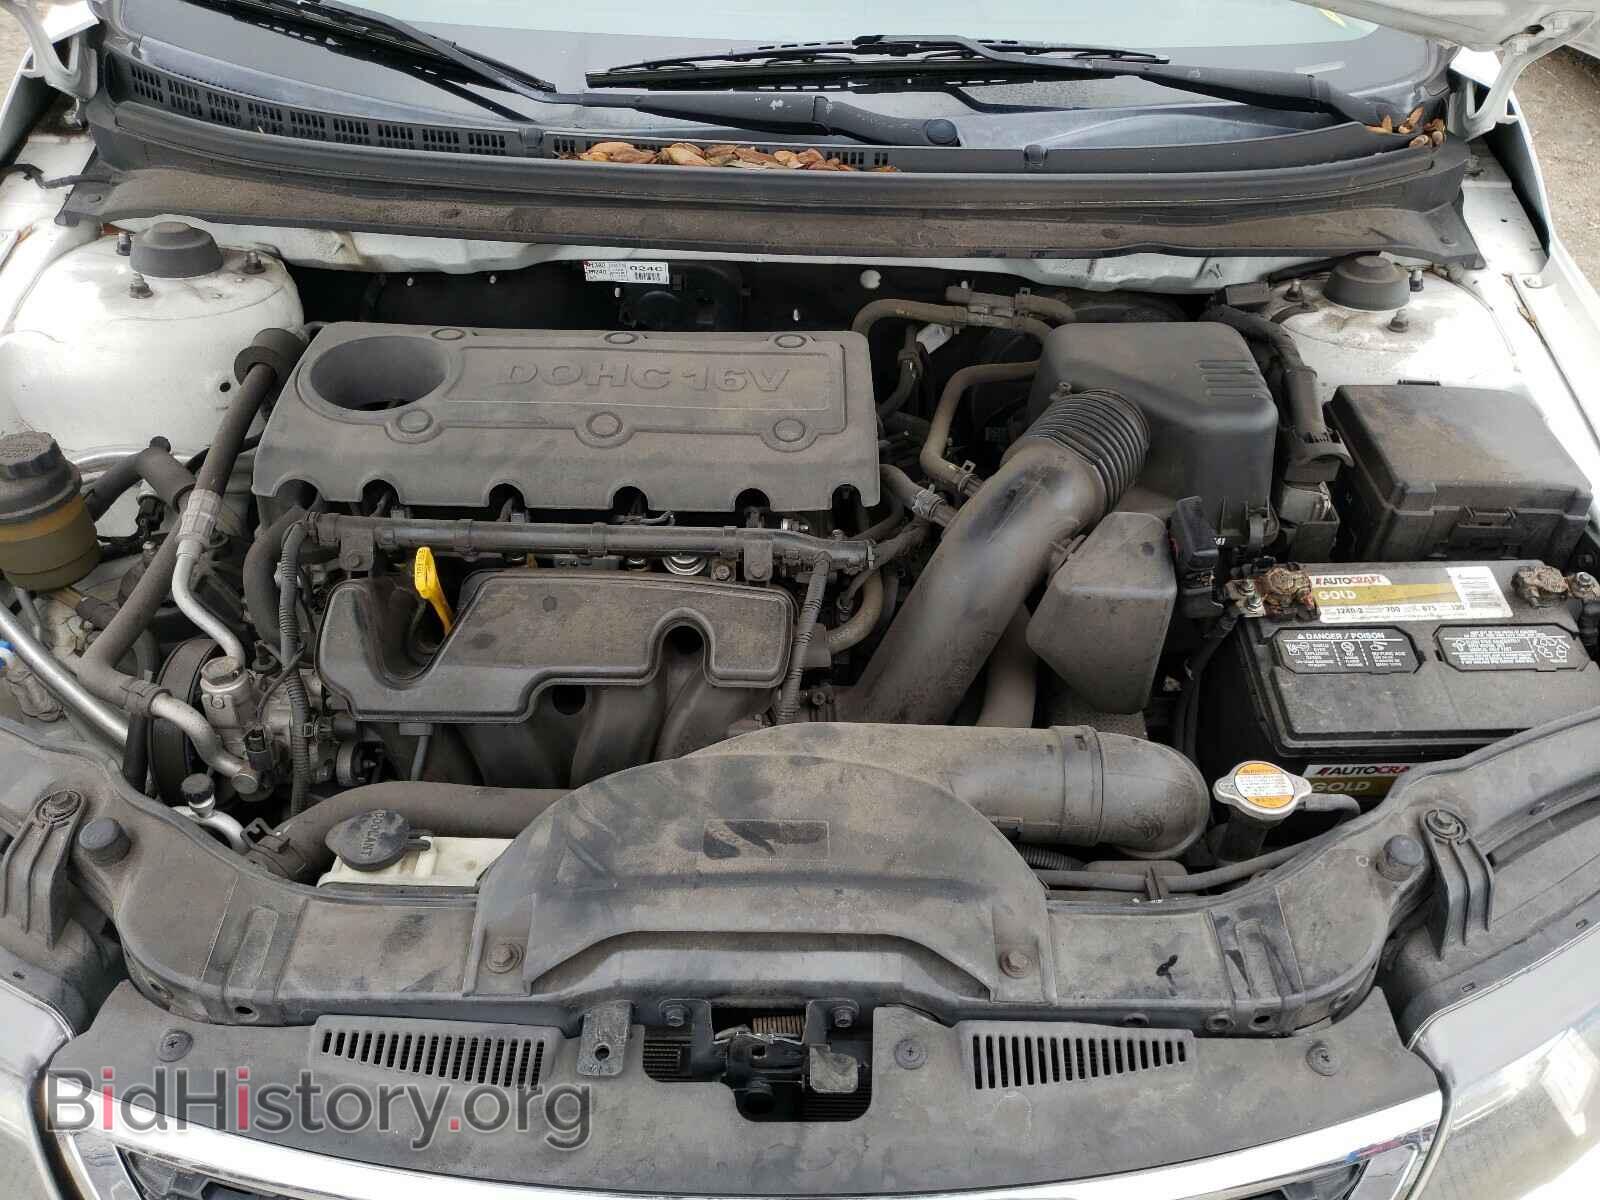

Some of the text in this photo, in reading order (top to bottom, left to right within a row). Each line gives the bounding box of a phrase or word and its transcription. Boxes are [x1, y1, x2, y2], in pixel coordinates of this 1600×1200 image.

[497, 363, 672, 390] DOHC
[681, 367, 791, 392] 16V
[1318, 590, 1357, 600] GOLD
[1350, 632, 1385, 640] POISON
[1312, 782, 1371, 792] GOLD
[361, 812, 384, 856] COOLANT
